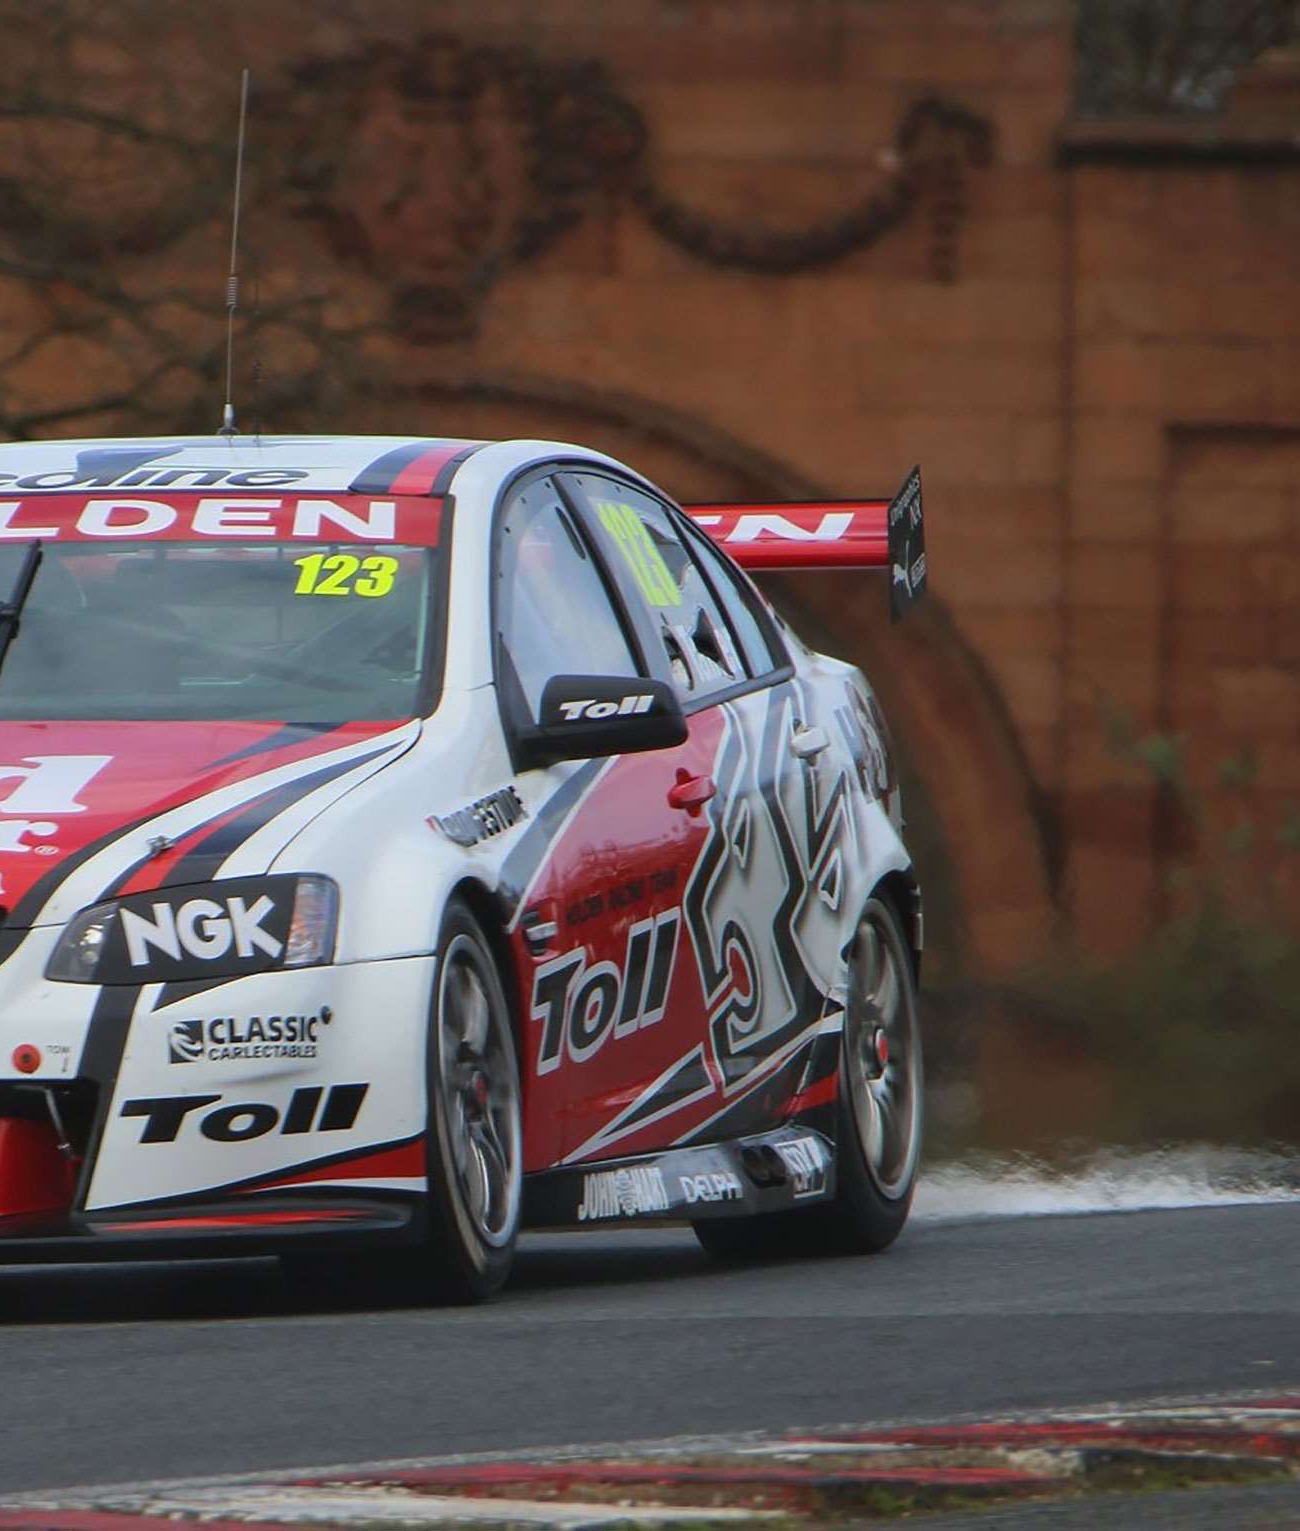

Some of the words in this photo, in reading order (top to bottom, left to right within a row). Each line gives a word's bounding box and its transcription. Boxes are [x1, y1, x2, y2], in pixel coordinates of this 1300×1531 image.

[293, 553, 399, 598] 123
[559, 695, 655, 722] Toll
[118, 894, 285, 967] NGK
[531, 908, 682, 1077] Toll
[208, 1016, 318, 1044] CLASSIC
[119, 1083, 371, 1144] Toll
